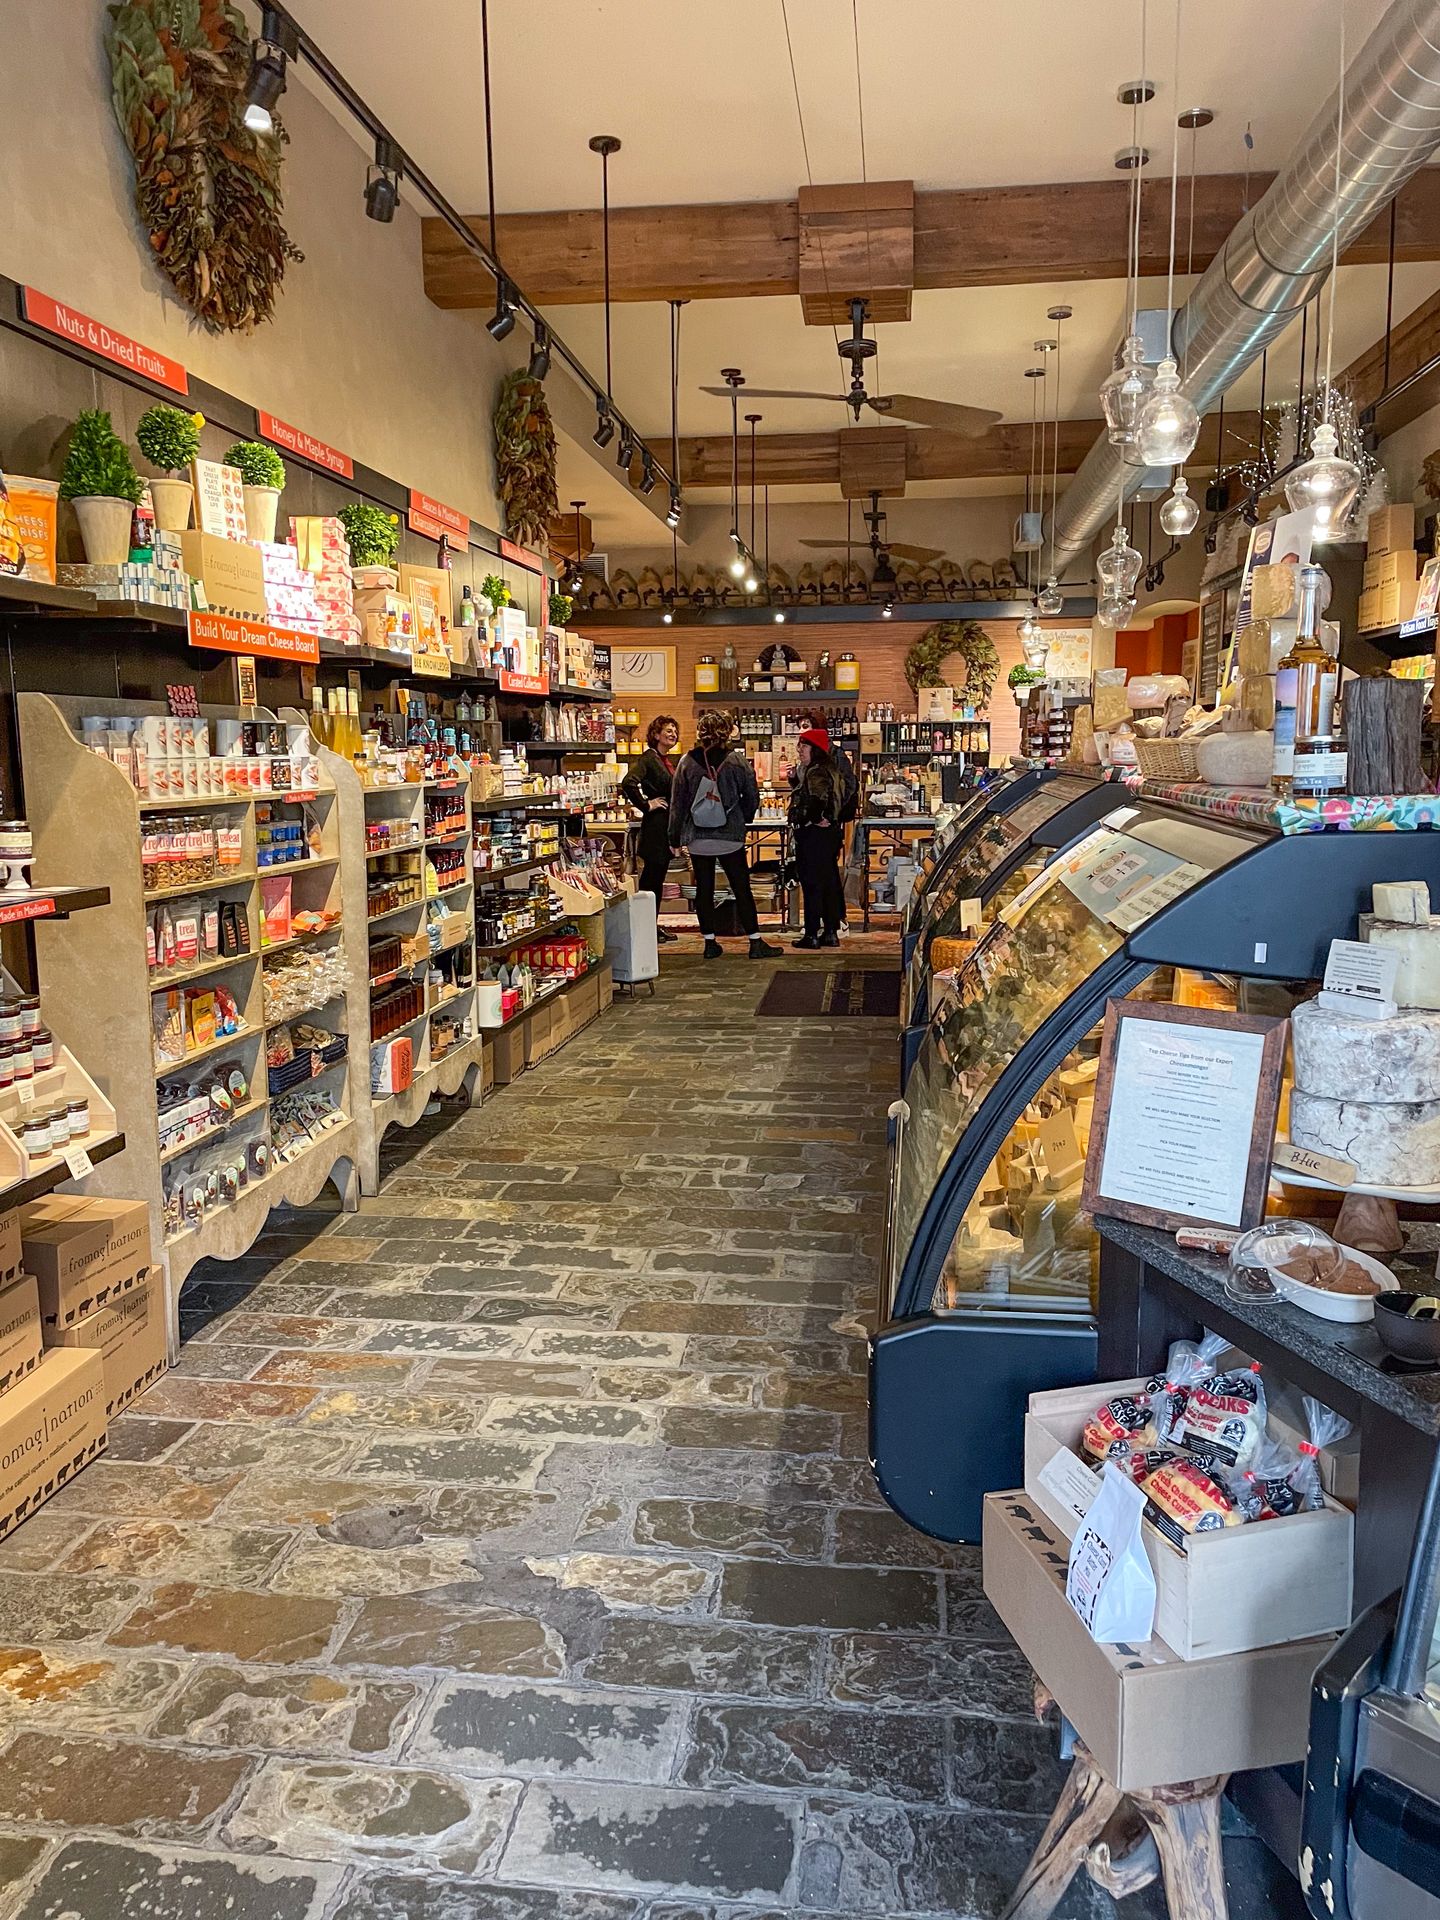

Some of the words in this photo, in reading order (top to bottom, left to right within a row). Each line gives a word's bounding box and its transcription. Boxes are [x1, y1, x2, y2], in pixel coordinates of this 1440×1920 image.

[55, 305, 86, 339] Nuts
[87, 323, 98, 346] &
[100, 327, 135, 364] Dried
[135, 347, 166, 378] Fruits
[271, 418, 296, 449] Honey
[297, 432, 304, 449] &
[304, 435, 325, 461] Maple
[325, 447, 345, 475] Syrup
[1400, 621, 1416, 635] Artisan
[1416, 618, 1427, 631] Food
[195, 619, 218, 639] Build
[219, 623, 239, 642] Your
[241, 626, 266, 647] Dream
[268, 632, 293, 652] Cheese
[295, 636, 315, 654] Board
[422, 659, 451, 673] KNOWLEDGE
[593, 654, 610, 664] PARIS
[507, 674, 524, 688] Curated
[523, 676, 543, 690] Collection
[879, 848, 892, 867] 6
[16, 908, 24, 917] in
[24, 902, 50, 915] Madison
[179, 923, 196, 936] treat
[1215, 1057, 1233, 1065] Expert
[1290, 1151, 1321, 1170] Blue
[0, 1386, 94, 1471] omagination
[1150, 1479, 1172, 1502] Cheese
[1171, 1484, 1203, 1513] Cheddar
